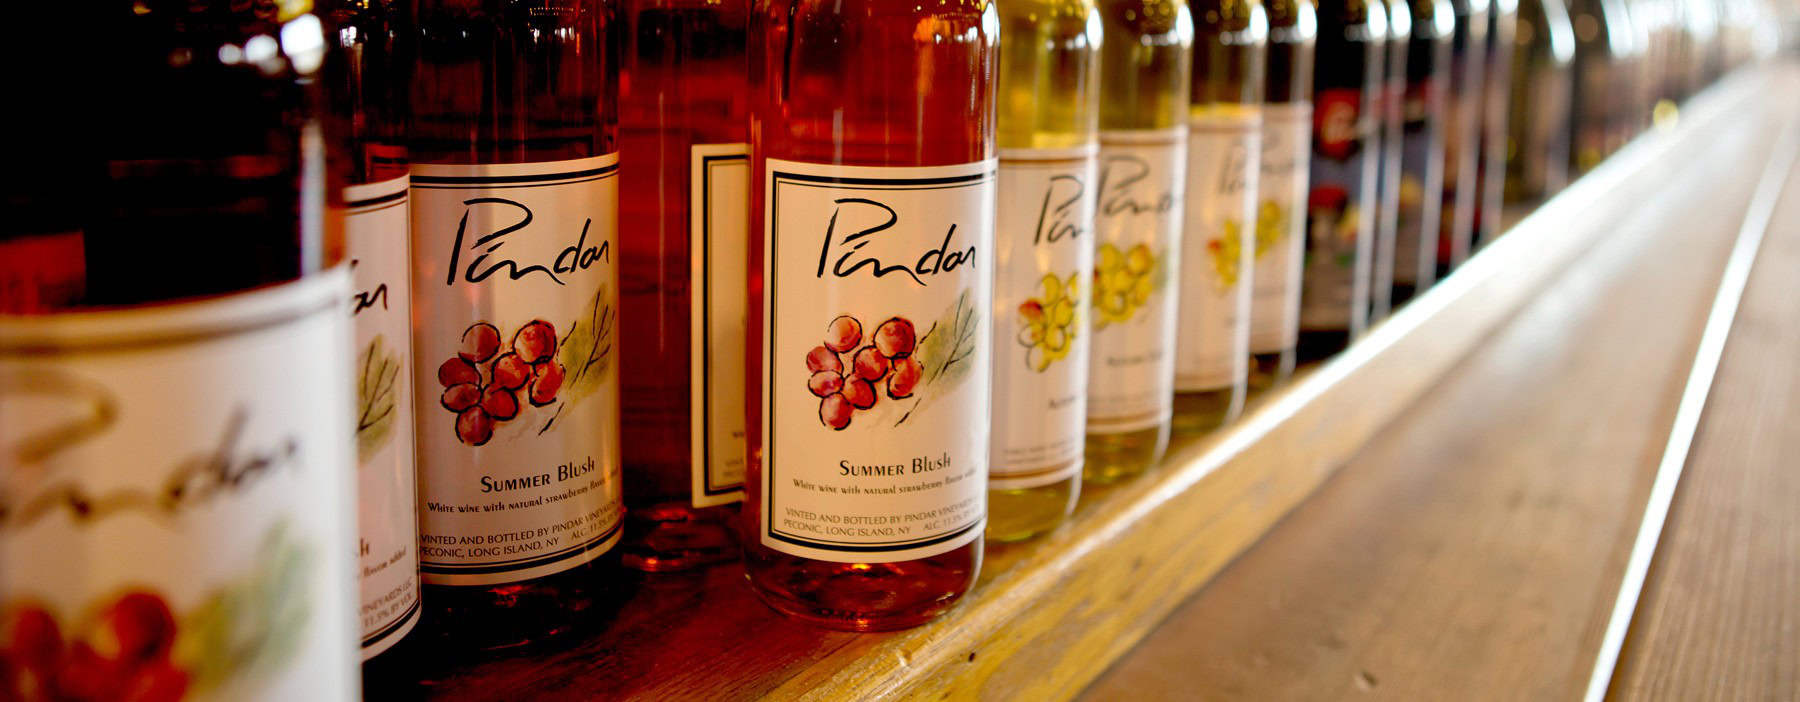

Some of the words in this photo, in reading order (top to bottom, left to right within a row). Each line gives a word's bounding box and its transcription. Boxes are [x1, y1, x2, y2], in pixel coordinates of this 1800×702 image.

[446, 197, 609, 285] Pindar
[817, 198, 976, 286] Pindar
[839, 459, 904, 477] SUMMER
[480, 474, 551, 493] SUMMER
[841, 485, 861, 494] with
[483, 501, 505, 512] with
[785, 507, 817, 521] VINTED
[819, 514, 841, 524] AND
[843, 514, 888, 525] BOTTLED
[890, 512, 902, 523] BY
[904, 506, 937, 522] PINDAR
[420, 533, 457, 545] VINTED
[459, 535, 485, 545] AND
[487, 530, 534, 545] BOTTLED
[537, 526, 550, 537] BY
[552, 517, 584, 534] PINDAR
[825, 526, 855, 536] LONG
[857, 527, 896, 537] ISLAND,
[898, 525, 911, 535] NY
[419, 546, 465, 559] PECONIC,
[468, 547, 500, 557] LONG
[503, 541, 543, 555] ISLAND,
[546, 537, 560, 547] NY
